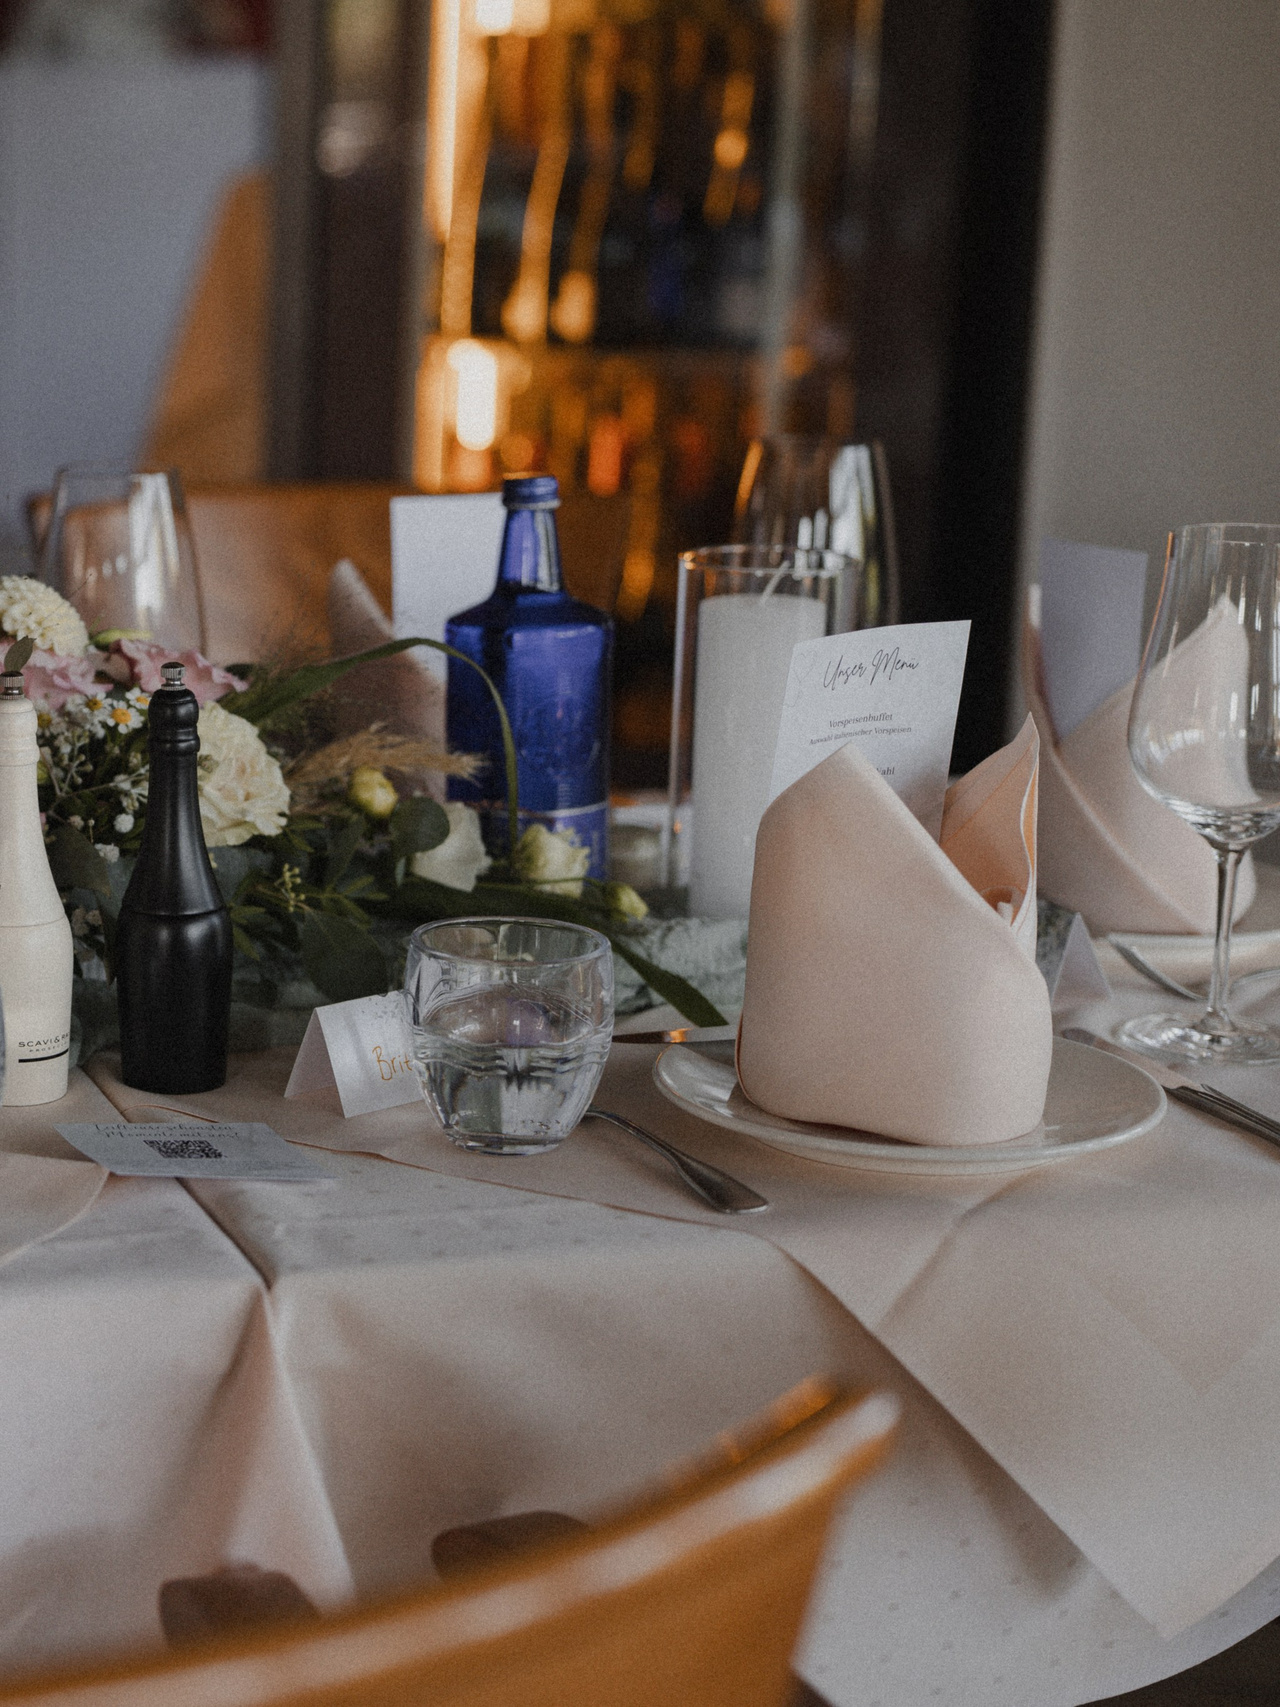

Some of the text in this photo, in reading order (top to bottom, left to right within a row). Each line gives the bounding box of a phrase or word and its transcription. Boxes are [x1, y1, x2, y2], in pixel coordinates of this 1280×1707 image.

[823, 647, 919, 691] Unser Menü
[829, 712, 894, 728] Vorspeisenbuffet
[874, 726, 912, 736] Vorspeisen
[18, 1038, 53, 1048] SCAVI
